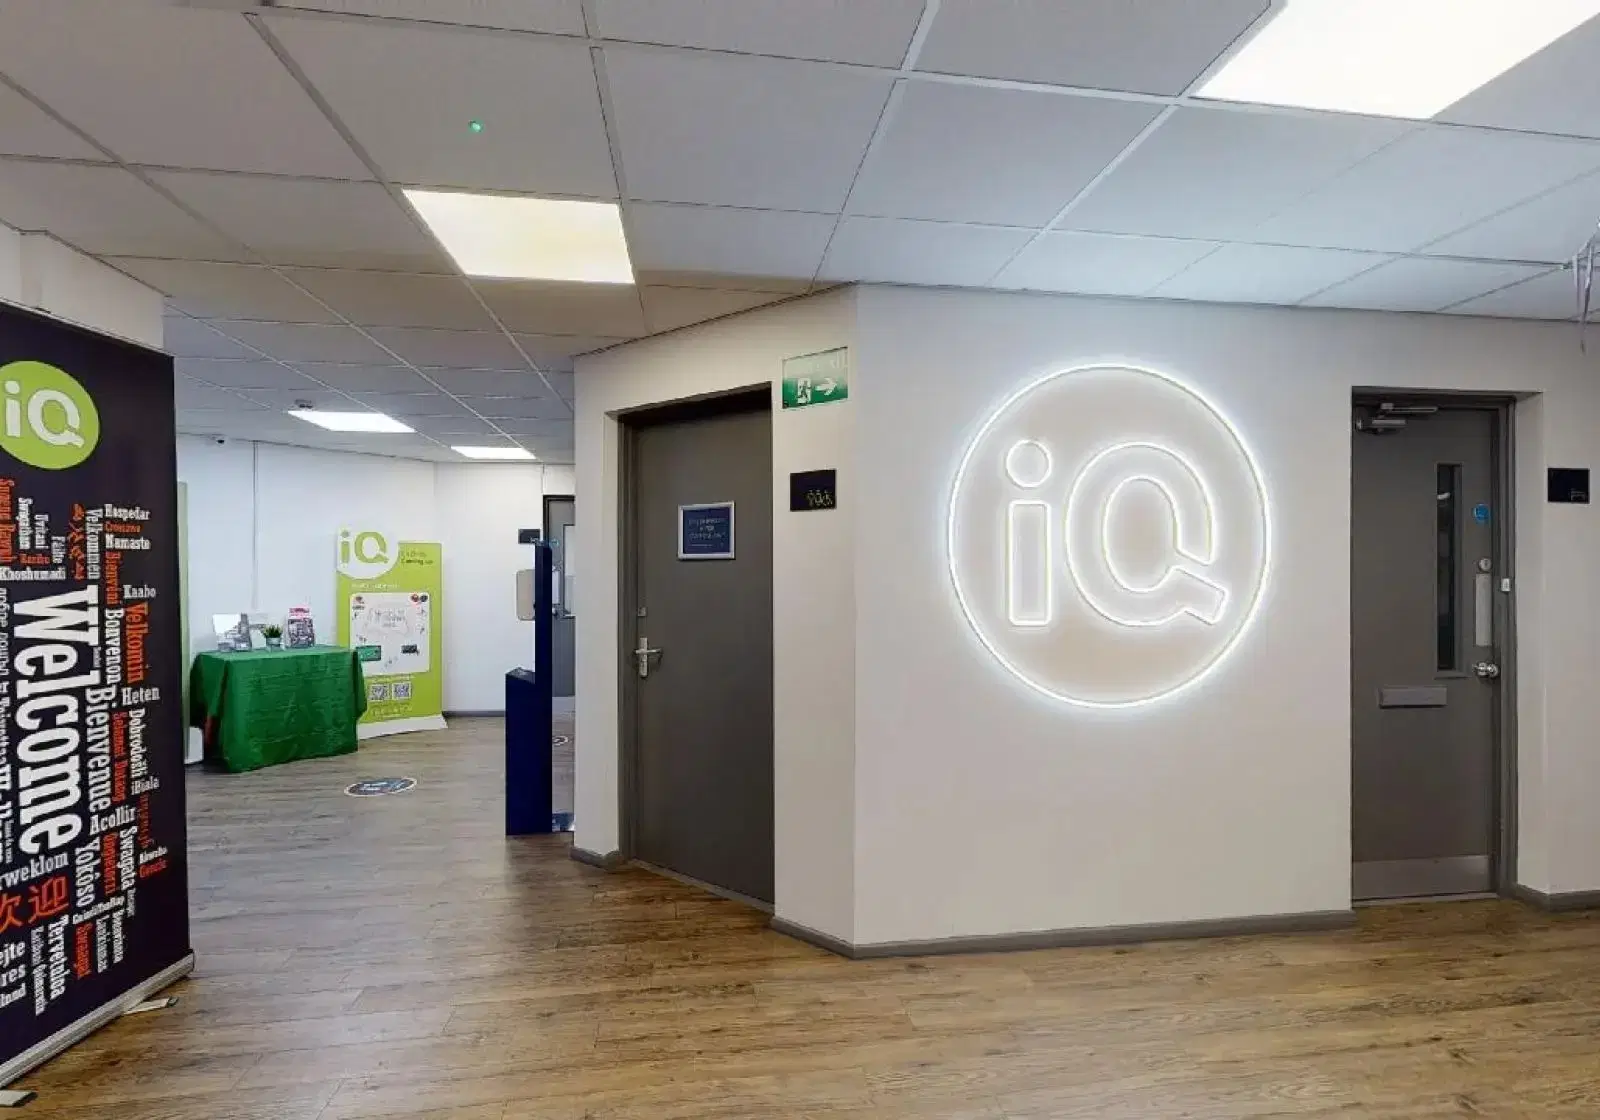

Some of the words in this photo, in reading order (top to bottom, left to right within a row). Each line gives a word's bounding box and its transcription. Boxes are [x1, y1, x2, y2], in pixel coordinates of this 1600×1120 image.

[4, 380, 84, 449] iQ
[86, 508, 103, 580] Velkommen
[105, 534, 151, 550] Namaste
[340, 529, 389, 565] iQ
[1005, 438, 1230, 627] iQ
[105, 608, 124, 683] Bonvenon
[14, 584, 101, 854] Welcome
[121, 687, 160, 706] Heten
[86, 684, 118, 812] Bienvenue
[118, 826, 137, 891] Swagata
